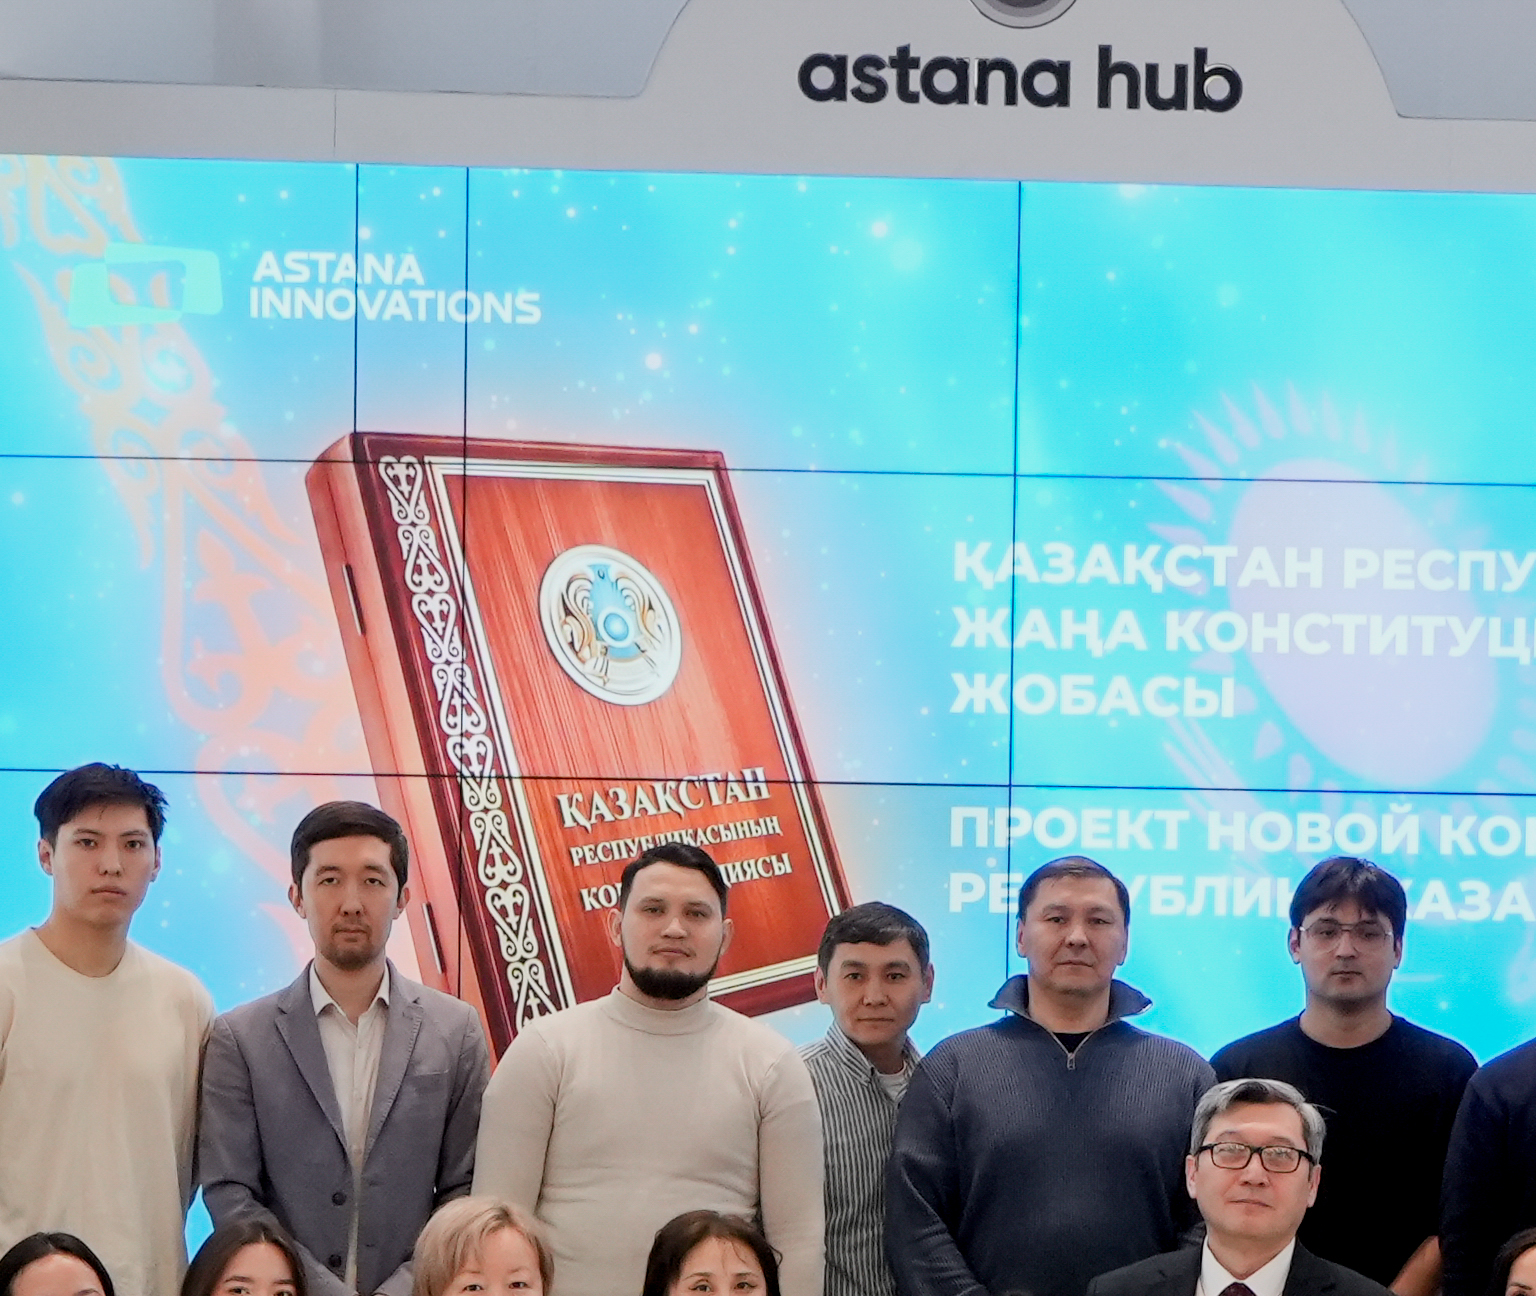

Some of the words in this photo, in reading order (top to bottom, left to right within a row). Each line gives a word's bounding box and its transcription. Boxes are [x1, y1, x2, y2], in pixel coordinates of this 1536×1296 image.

[798, 43, 1071, 108] astana
[1097, 44, 1243, 113] hub
[253, 250, 425, 286] ASTANA
[249, 286, 542, 325] INNOVATIONS
[953, 540, 1324, 593] ҚАЗАҚСТАН
[950, 605, 1148, 658] ЖАҢА
[949, 672, 1235, 718] ЖОБАСЫ
[555, 766, 771, 834] ҚАЗАҚСТАН
[950, 806, 1189, 850] ПРОЕКТ
[1206, 803, 1420, 854] НОВОЙ
